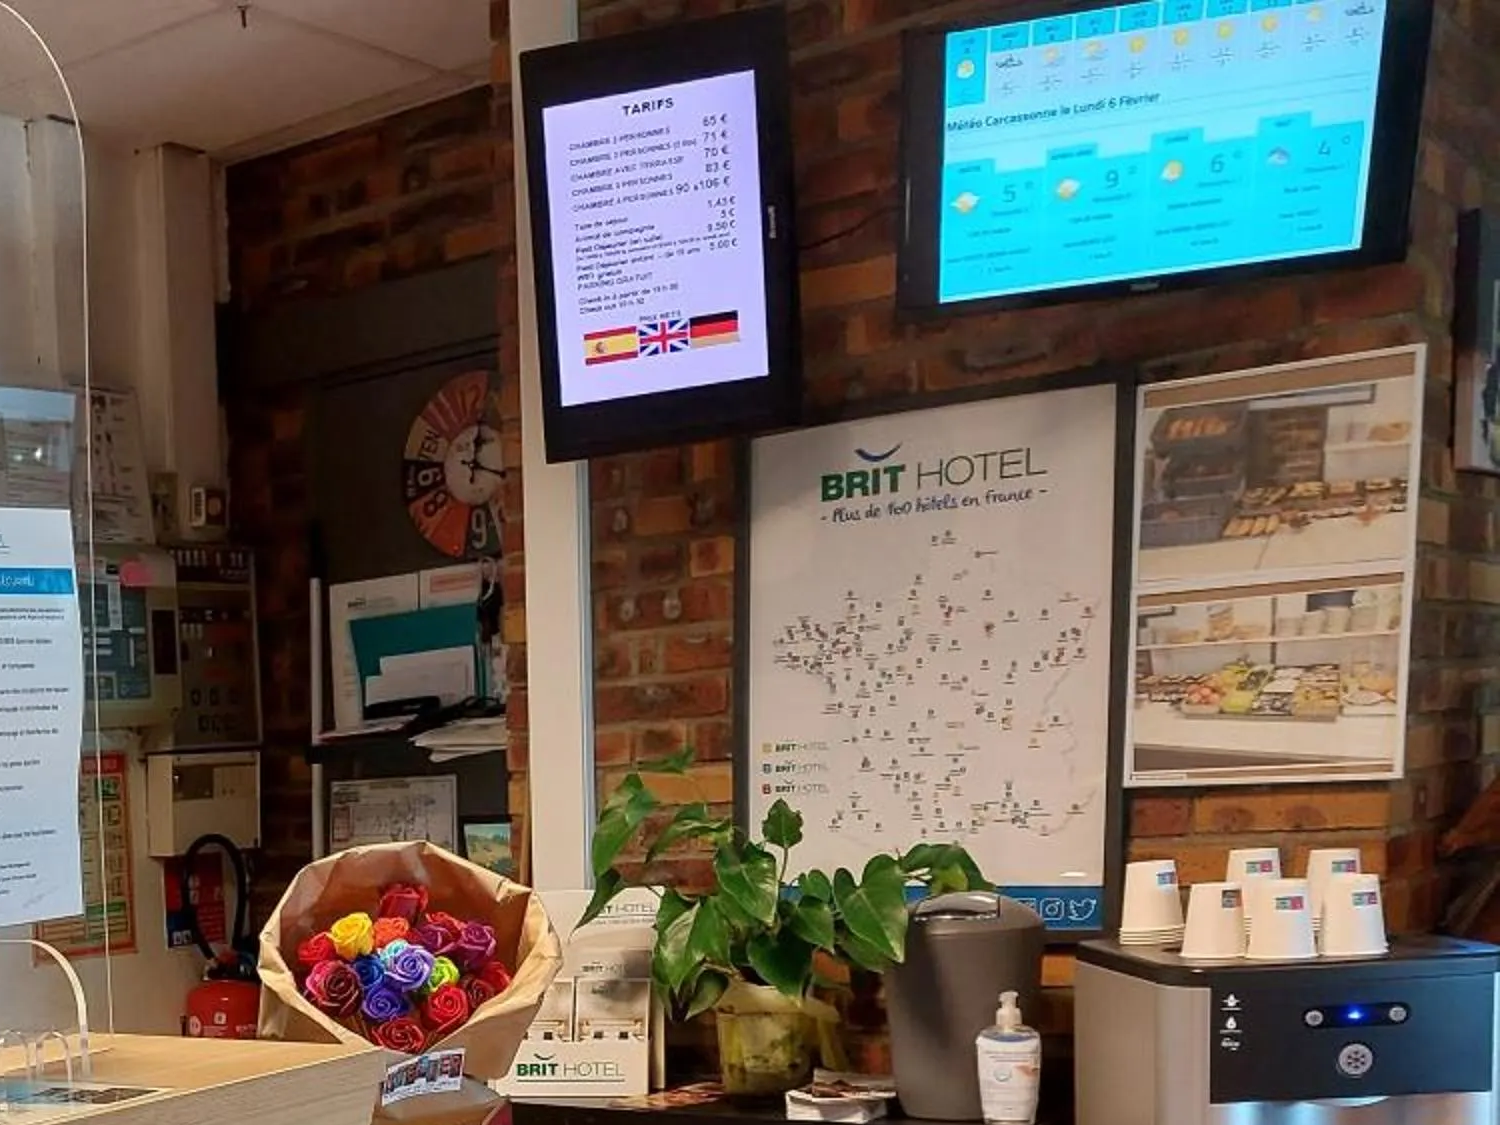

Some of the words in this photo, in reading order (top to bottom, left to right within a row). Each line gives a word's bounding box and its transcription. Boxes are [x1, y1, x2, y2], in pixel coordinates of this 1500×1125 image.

[623, 98, 674, 116] TARIFS
[986, 109, 1057, 127] Carcassonne
[1060, 106, 1070, 116] le
[1073, 99, 1104, 114] Lundi
[1108, 97, 1117, 109] 6
[675, 182, 690, 194] 90
[821, 464, 906, 501] BRIT
[917, 448, 1047, 489] HOTEL
[832, 507, 861, 523] Plus
[865, 504, 880, 518] de
[961, 494, 979, 506] en
[985, 487, 1032, 505] France
[616, 904, 655, 912] HOTEL
[516, 1063, 558, 1077] BRIT
[563, 1062, 625, 1077] HOTEL
